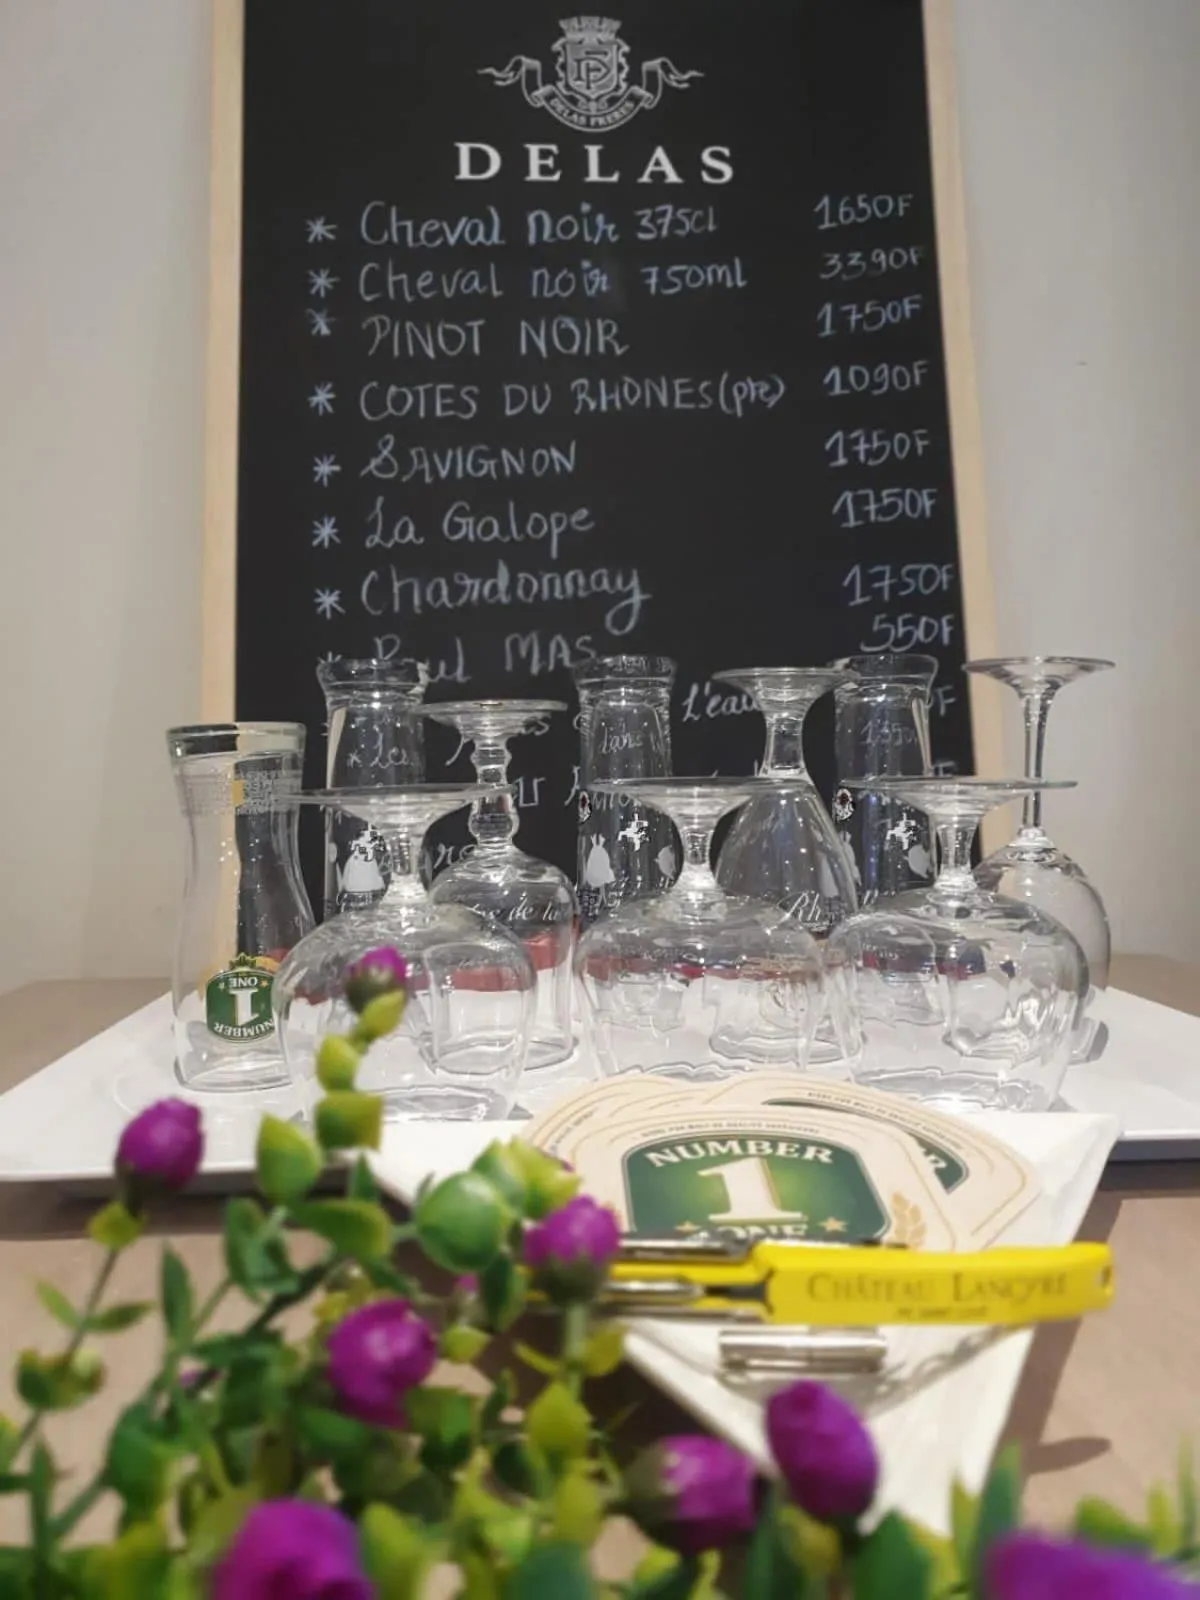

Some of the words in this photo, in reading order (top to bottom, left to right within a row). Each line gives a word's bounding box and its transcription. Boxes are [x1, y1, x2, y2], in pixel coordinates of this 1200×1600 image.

[453, 142, 734, 185] DELAS
[361, 201, 505, 248] Cheval
[527, 201, 619, 246] noir
[814, 194, 913, 230] 1650F
[359, 260, 503, 303] Cheval
[532, 259, 610, 298] noir
[640, 257, 748, 295] 750ml
[819, 246, 926, 281] 3390F
[362, 314, 486, 360] PINOT
[520, 317, 630, 359] NOIR
[816, 295, 922, 338] 1750F
[360, 381, 480, 421] COTES
[504, 383, 551, 416] DU
[823, 361, 929, 397] 1090F
[359, 434, 577, 485] SAVIGNON
[825, 429, 931, 468] 1750F
[365, 496, 426, 549] La
[443, 501, 596, 560] Galope
[832, 488, 938, 528] 1750F
[361, 559, 653, 637] Chardonnay
[842, 564, 954, 606] 1750F
[860, 613, 955, 653] 550F
[646, 1139, 833, 1167] NUMBER
[697, 1157, 803, 1221] 1
